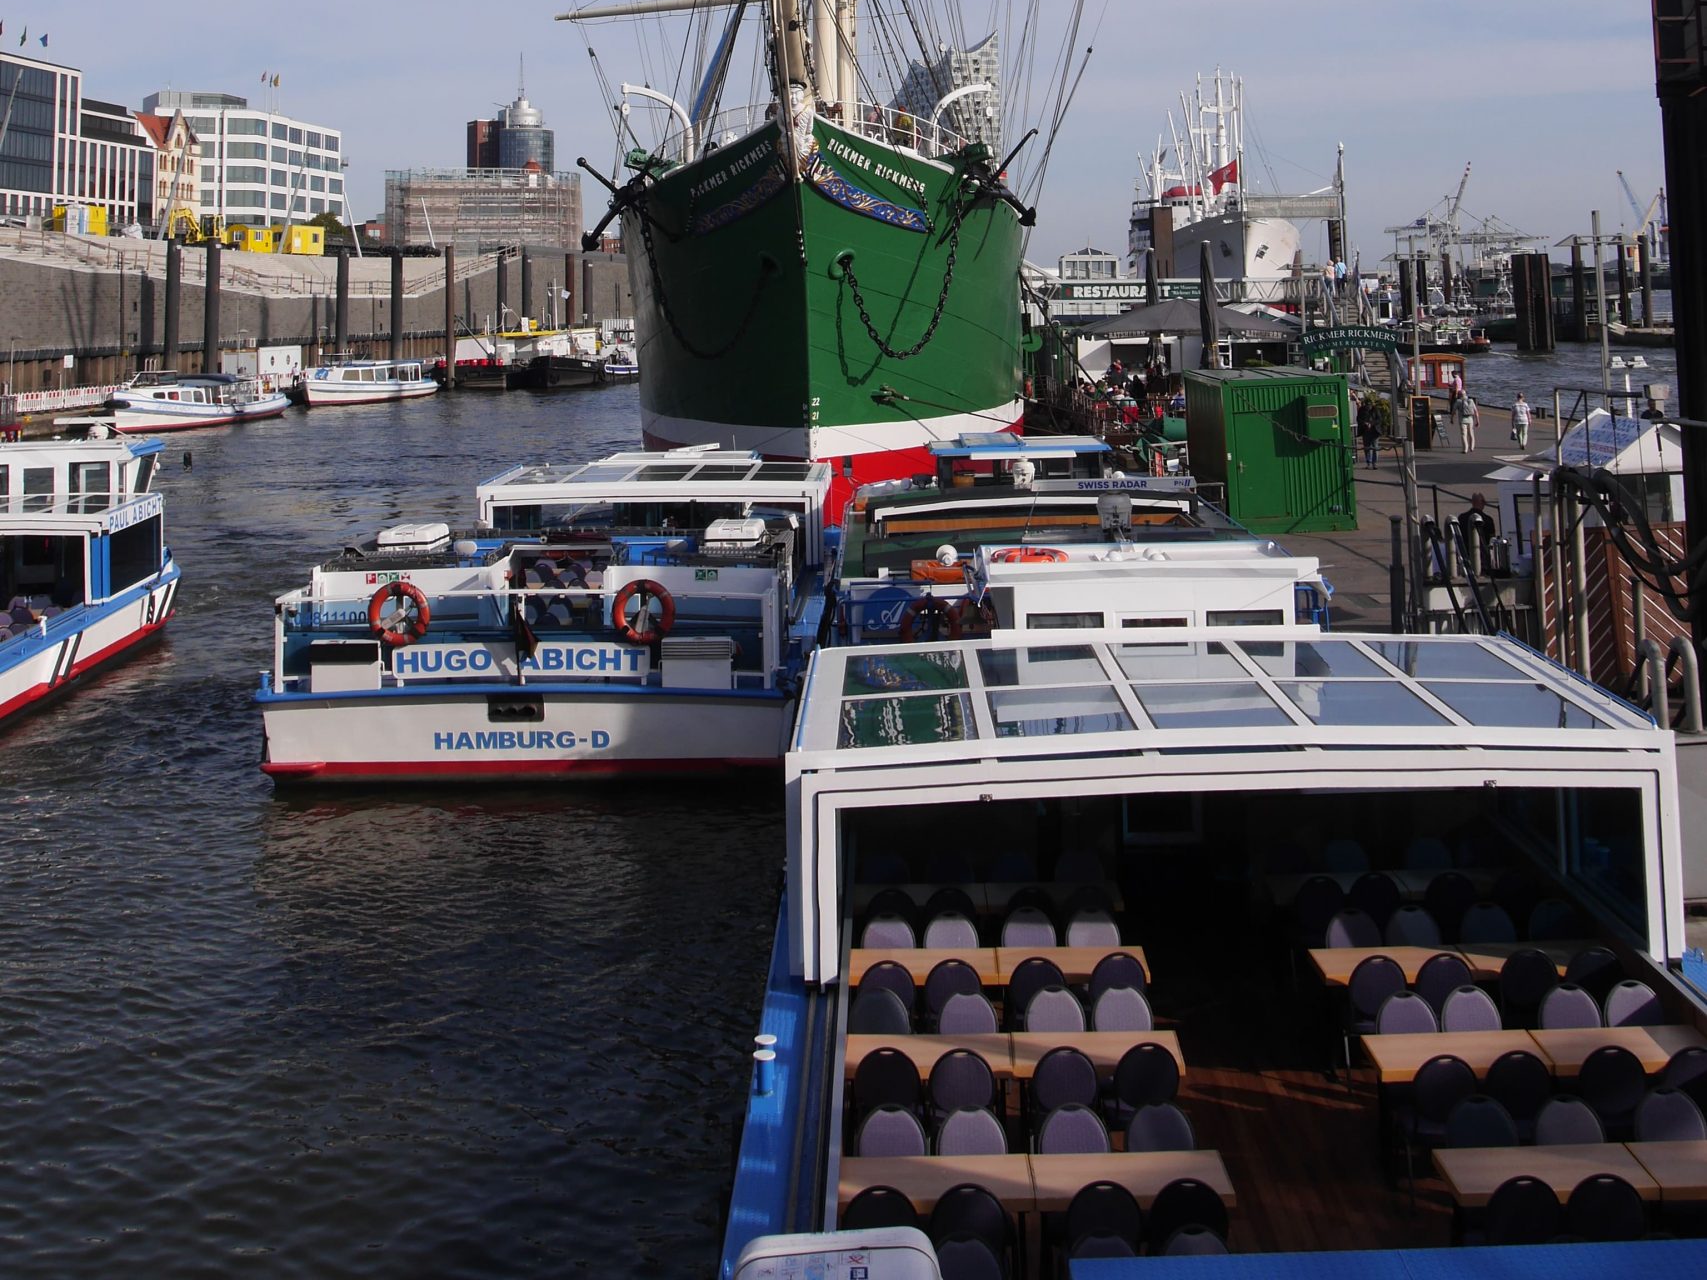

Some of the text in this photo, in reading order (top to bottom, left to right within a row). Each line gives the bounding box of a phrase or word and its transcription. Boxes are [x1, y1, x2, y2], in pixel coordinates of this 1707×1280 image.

[730, 140, 772, 177] RICKMERS
[827, 138, 926, 194] RICKMER RICKMERS
[1303, 329, 1396, 345] RICKMER RICKMERS
[812, 397, 820, 407] 22
[812, 411, 820, 421] 21
[1078, 480, 1110, 490] SWISS
[1112, 480, 1148, 489] RADAR
[109, 496, 162, 533] PAUL ABICHT
[396, 647, 646, 674] HUGO ABICHT
